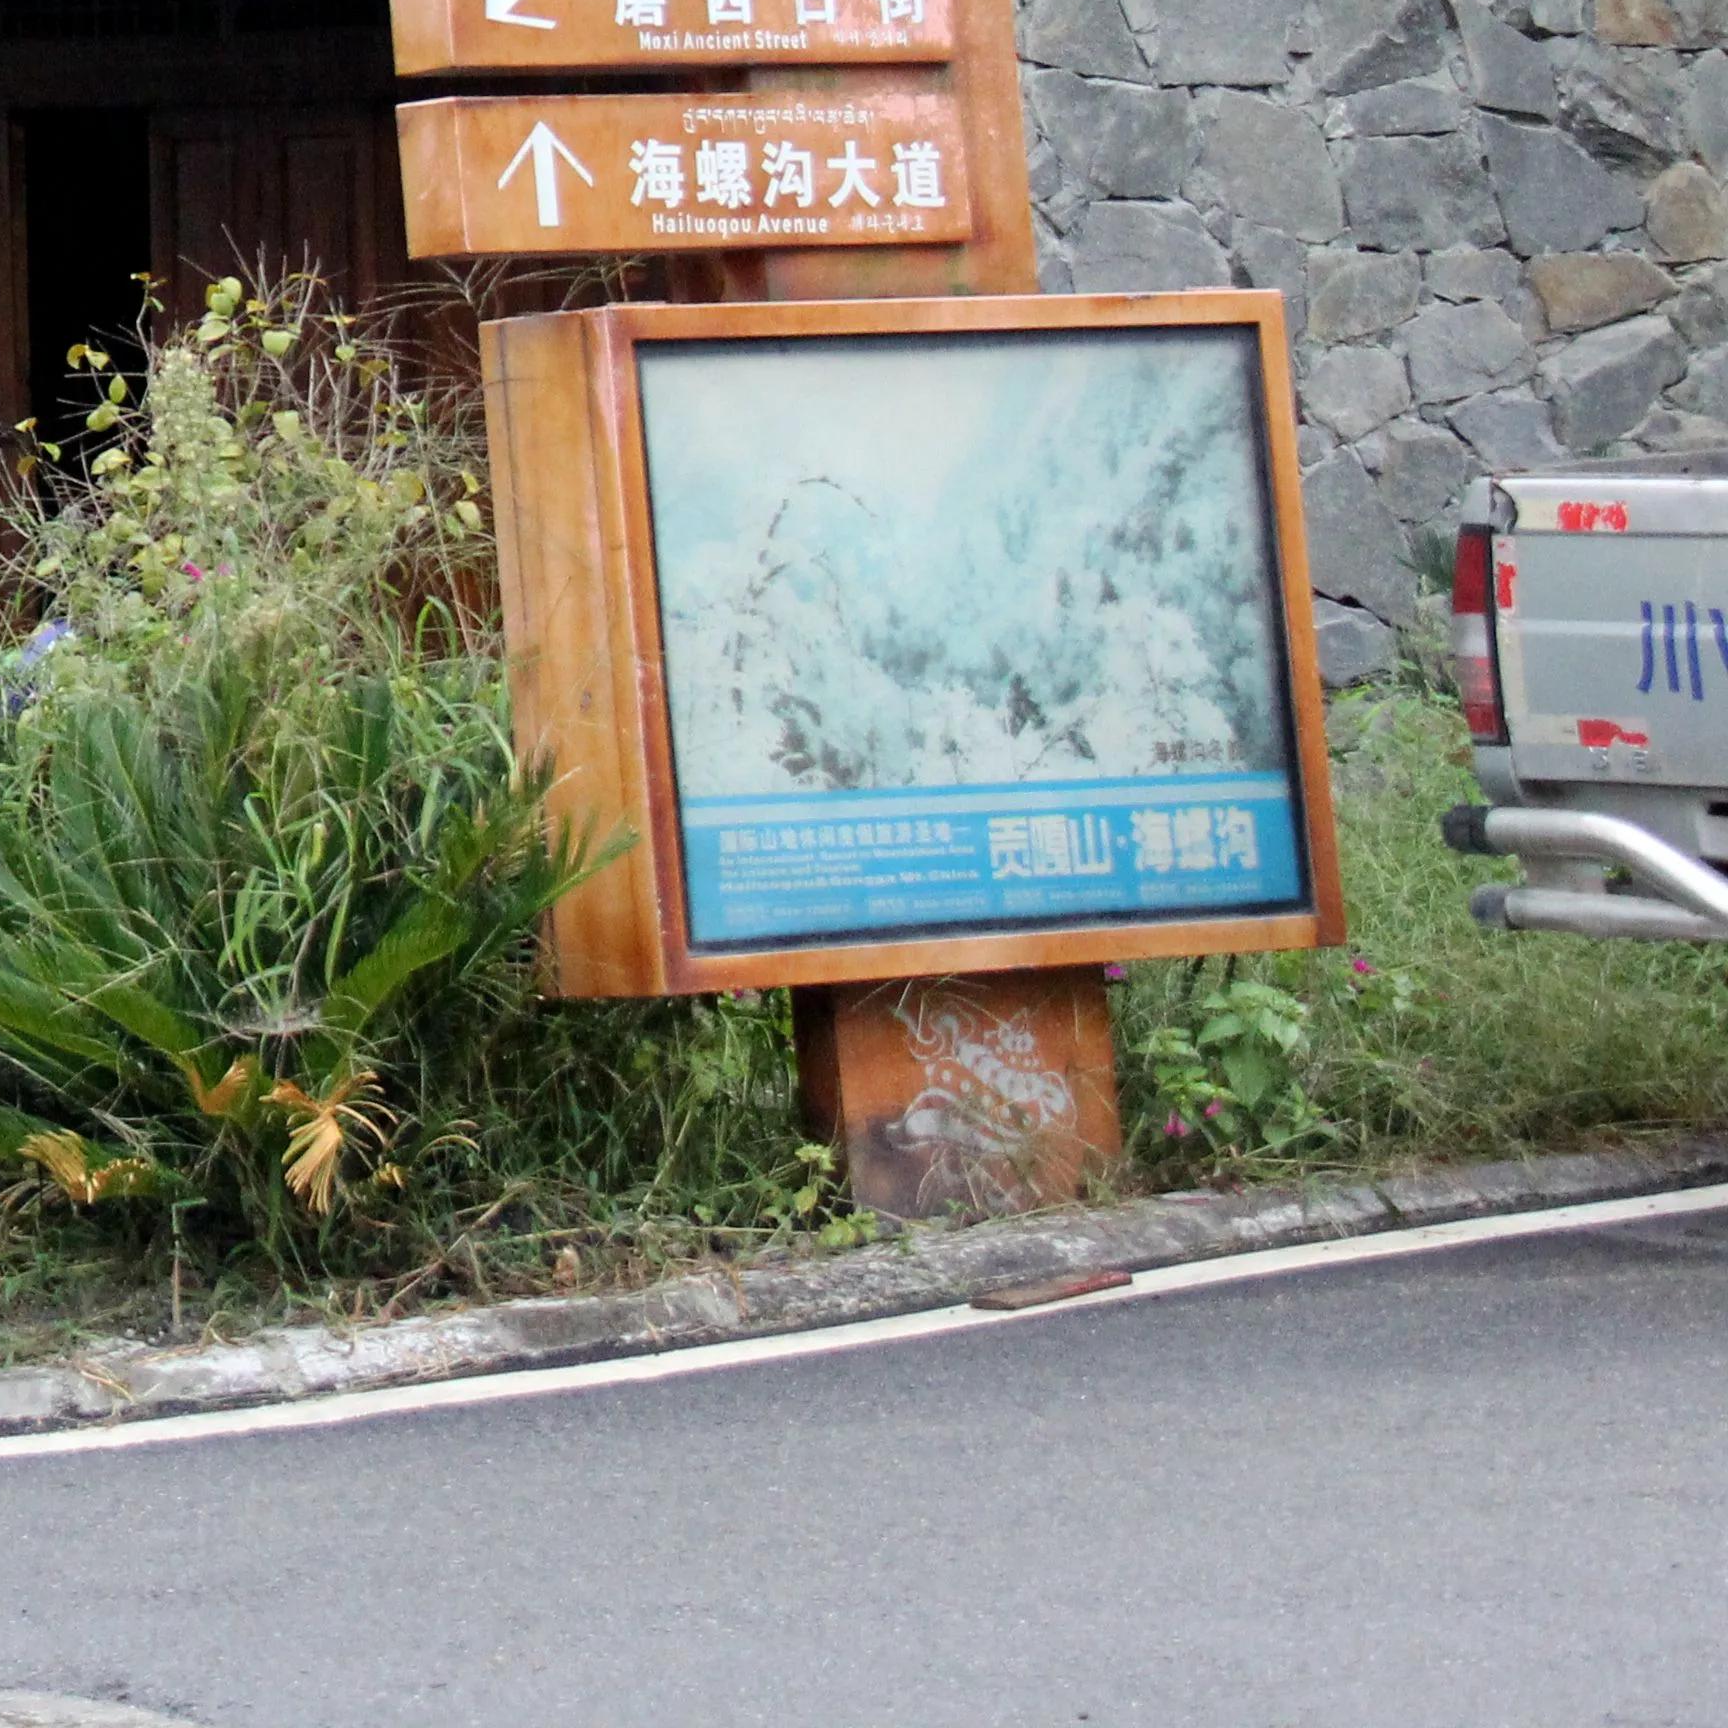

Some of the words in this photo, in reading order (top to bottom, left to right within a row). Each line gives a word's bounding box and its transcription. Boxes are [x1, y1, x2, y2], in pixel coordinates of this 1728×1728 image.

[639, 30, 678, 50] Moxi
[683, 30, 750, 50] Ancient
[755, 29, 808, 49] Street
[627, 138, 946, 209] 海螺沟大道
[651, 213, 753, 240] Hailuogou
[757, 213, 829, 235] Avenue
[988, 805, 1259, 880] 贡嘎山·海螺沟
